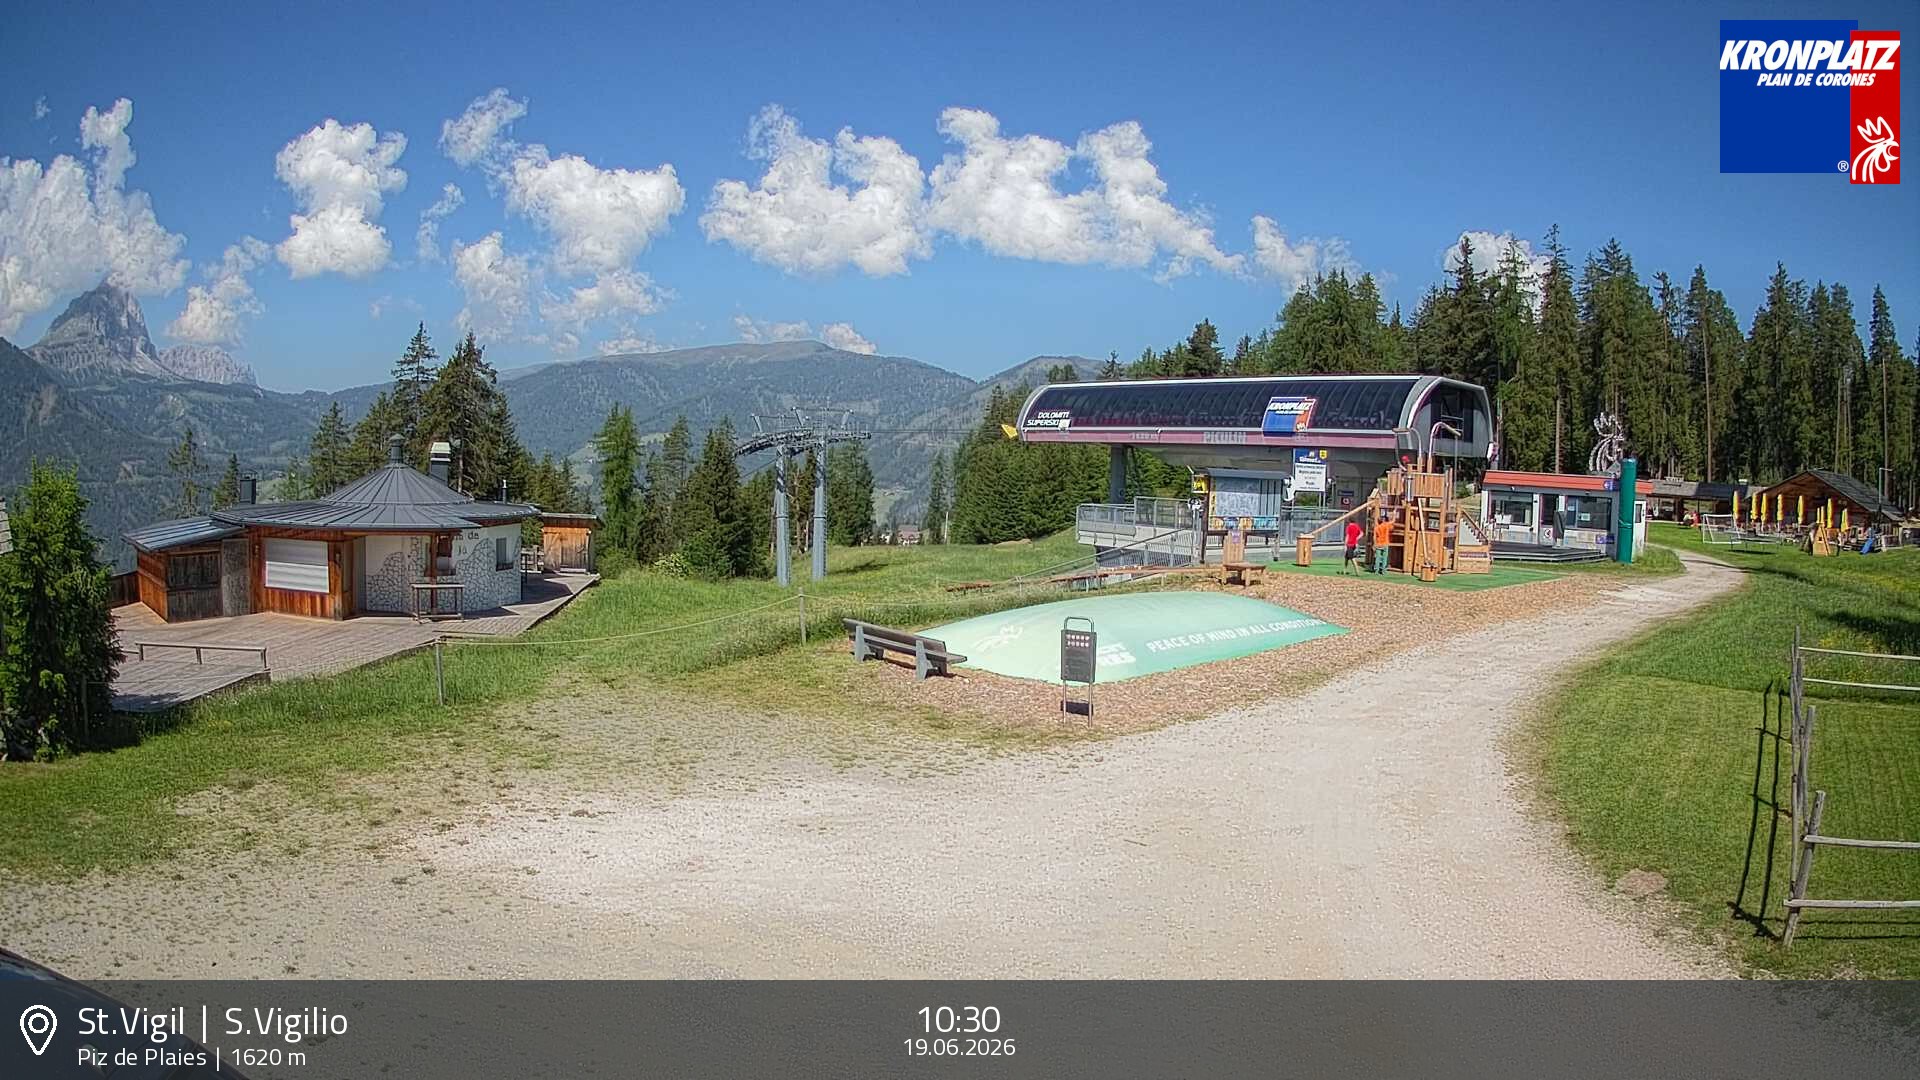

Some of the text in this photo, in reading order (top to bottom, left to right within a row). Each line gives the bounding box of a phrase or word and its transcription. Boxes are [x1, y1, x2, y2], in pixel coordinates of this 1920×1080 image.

[1037, 411, 1070, 419] DOLOMITI
[1146, 636, 1190, 653] PEACE
[1188, 633, 1205, 645] OF
[1205, 629, 1237, 641] MIND
[1235, 627, 1250, 637] IN
[1249, 624, 1271, 634] ALL
